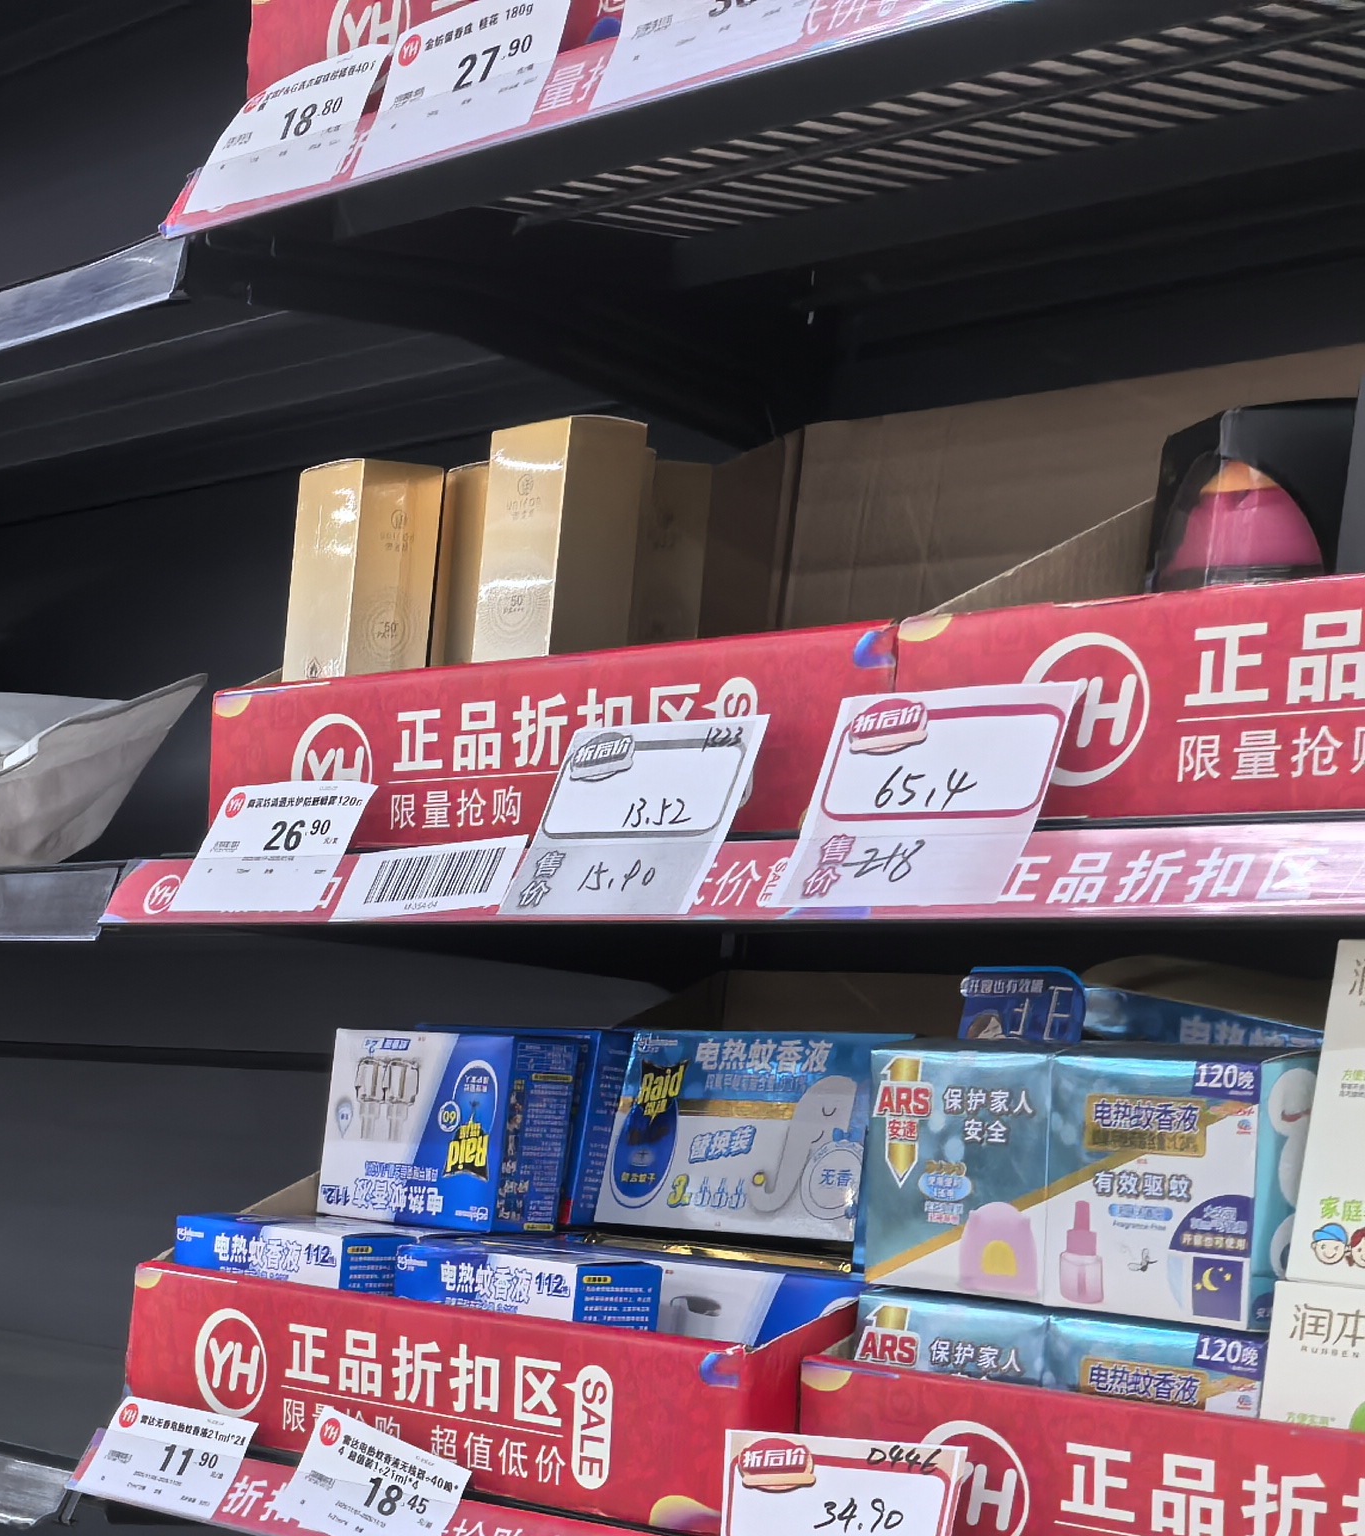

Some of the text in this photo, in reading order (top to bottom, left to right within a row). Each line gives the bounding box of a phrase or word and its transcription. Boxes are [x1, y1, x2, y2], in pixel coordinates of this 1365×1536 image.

[342, 0, 402, 48] YH
[505, 3, 534, 22] 180g
[452, 33, 533, 93] 27.90
[280, 97, 343, 140] 18.80
[851, 702, 925, 737] 折后价
[575, 738, 632, 762] 折后价
[391, 786, 522, 830] 限量抢购
[623, 798, 691, 827] 13.52
[263, 819, 331, 851] 26.90
[519, 850, 566, 908] 售价
[802, 833, 853, 900] 售价
[695, 1039, 833, 1073] 电热蚊香液
[638, 1065, 688, 1104] Raid
[1195, 1063, 1255, 1090] 120晚
[876, 1087, 933, 1116] ARS
[943, 1087, 1034, 1115] 保护家人
[1094, 1100, 1200, 1133] 电热蚊香液
[689, 1125, 756, 1163] 替换装
[888, 1120, 917, 1141] 安速
[964, 1119, 1008, 1143] 安全
[446, 1135, 489, 1172] Raid
[819, 1169, 853, 1186] 无香
[1094, 1170, 1192, 1201] 有效驱蚊
[352, 1180, 443, 1216] 电热蚊香液
[213, 1232, 300, 1272] 电热蚊香液
[440, 1260, 532, 1303] 电热蚊香液
[1289, 1303, 1365, 1348] 润本
[208, 1337, 258, 1394] YH
[860, 1334, 918, 1365] ARS
[929, 1338, 1022, 1374] 保护家人
[1199, 1335, 1260, 1367] 120晚
[283, 1322, 563, 1427] 正品折扣区
[1089, 1363, 1200, 1405] 电热蚊香液
[578, 1373, 607, 1479] SALE
[158, 1444, 218, 1477] 11.90
[430, 1424, 566, 1486] 超值低价
[742, 1447, 807, 1471] 折后价
[363, 1477, 429, 1516] 18.45
